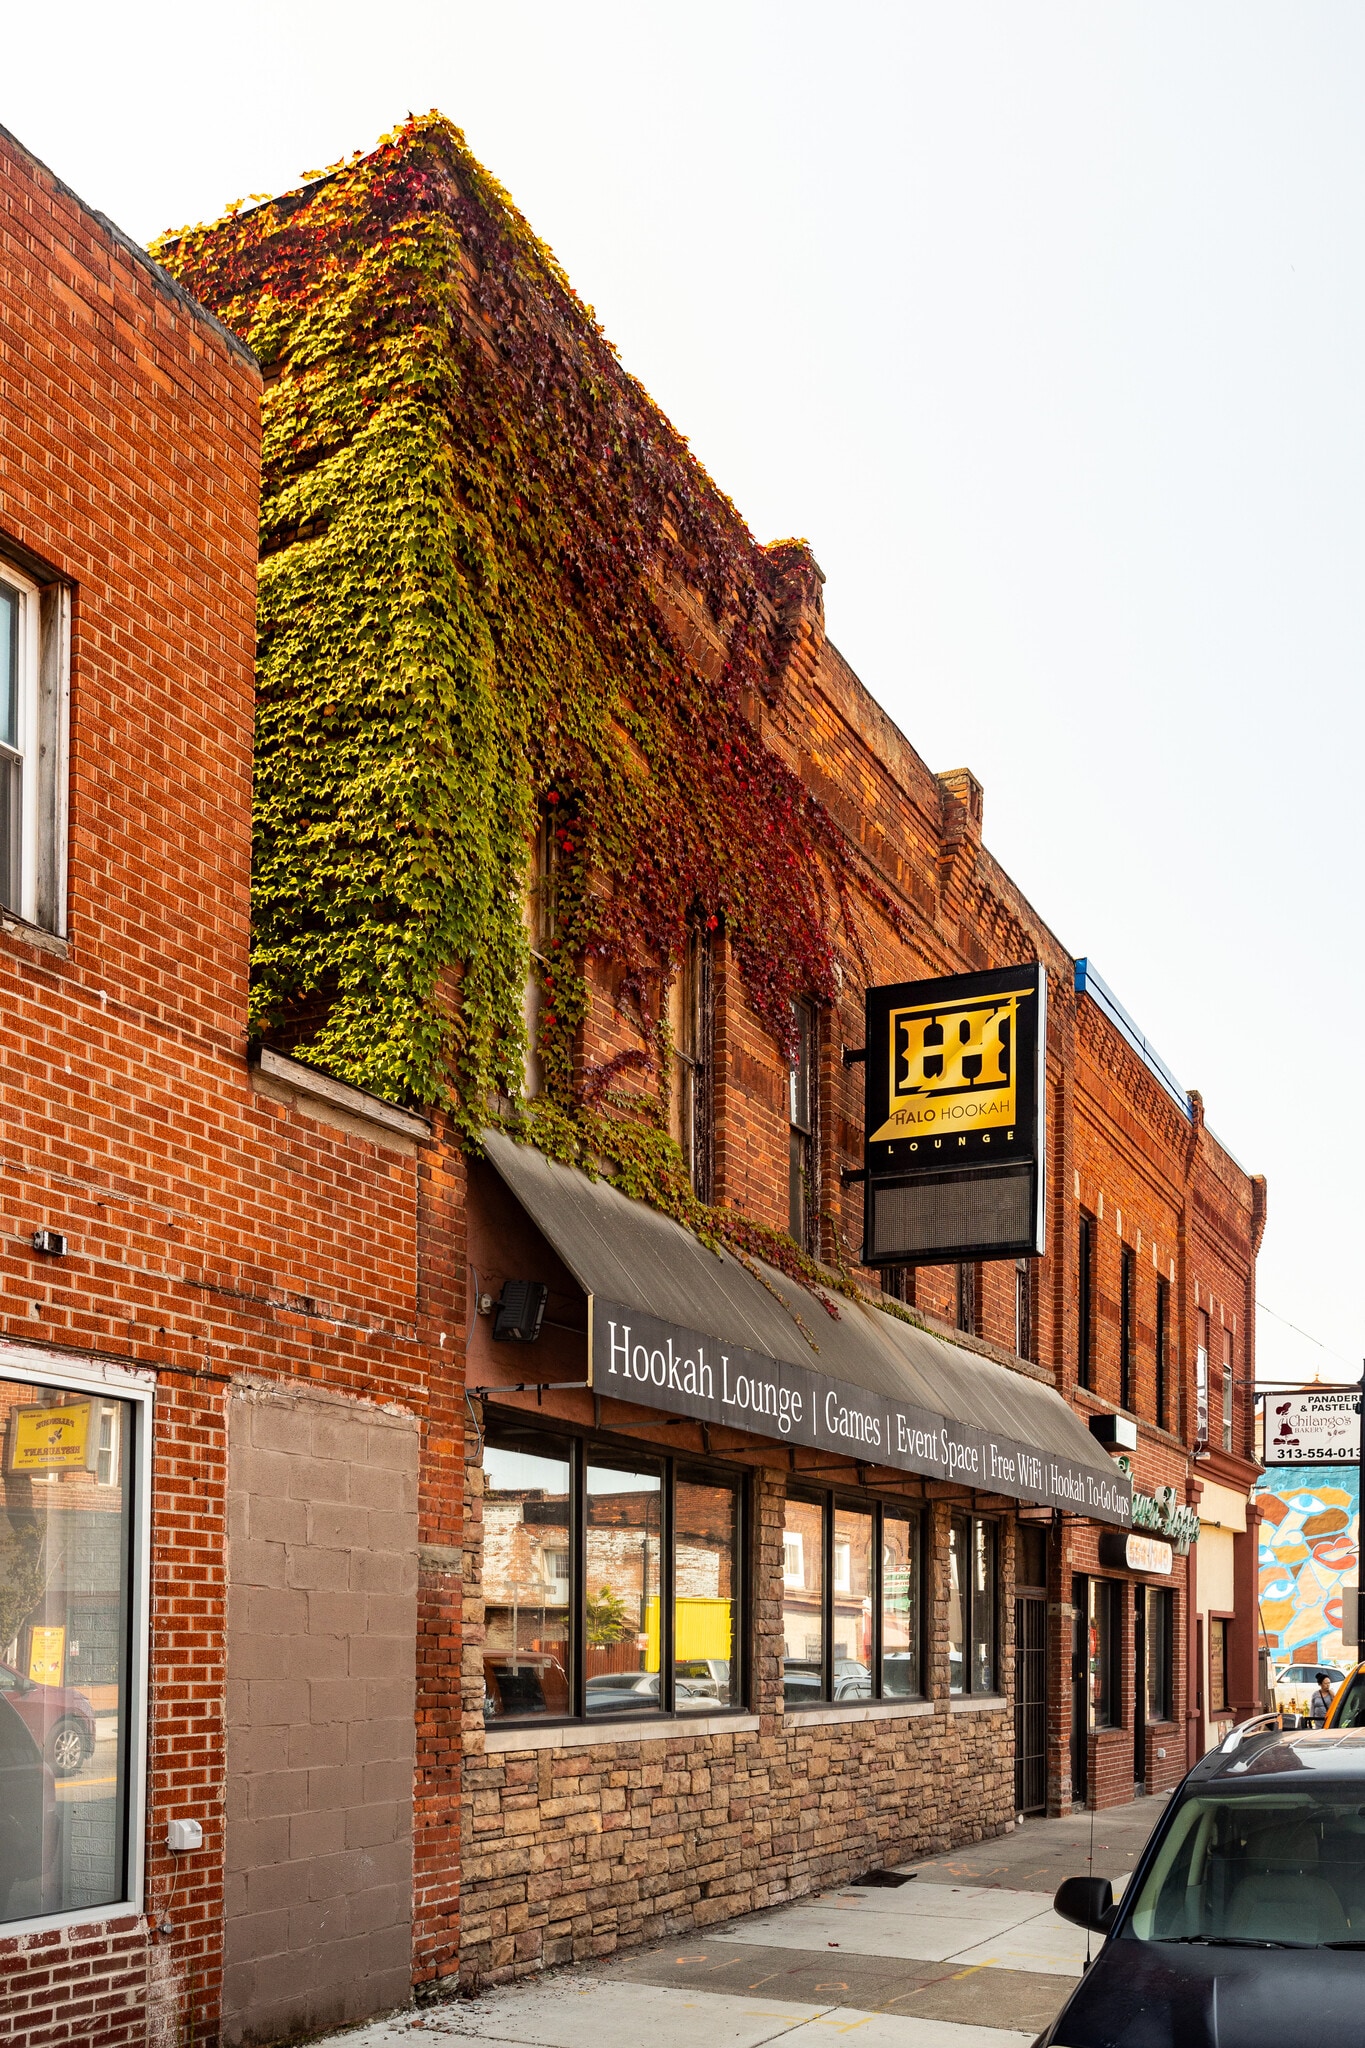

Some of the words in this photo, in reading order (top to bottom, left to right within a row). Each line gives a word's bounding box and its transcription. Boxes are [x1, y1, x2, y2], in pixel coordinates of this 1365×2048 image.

[890, 1109, 936, 1126] HALO
[941, 1100, 1010, 1120] HOOKAH
[888, 1131, 1014, 1154] LOUNGE
[607, 1320, 714, 1399] Hookah
[721, 1355, 803, 1433] Lounge
[825, 1391, 881, 1446] Games
[896, 1413, 938, 1461] Event
[940, 1428, 978, 1477] Space
[990, 1443, 1016, 1482] Free
[1017, 1452, 1043, 1490] WiFi
[1050, 1463, 1085, 1503] Hookah
[1087, 1476, 1110, 1510] To-Go
[1111, 1485, 1130, 1522] Cups
[1288, 1414, 1352, 1429] Chilango's
[1277, 1448, 1360, 1459] 313-554-013
